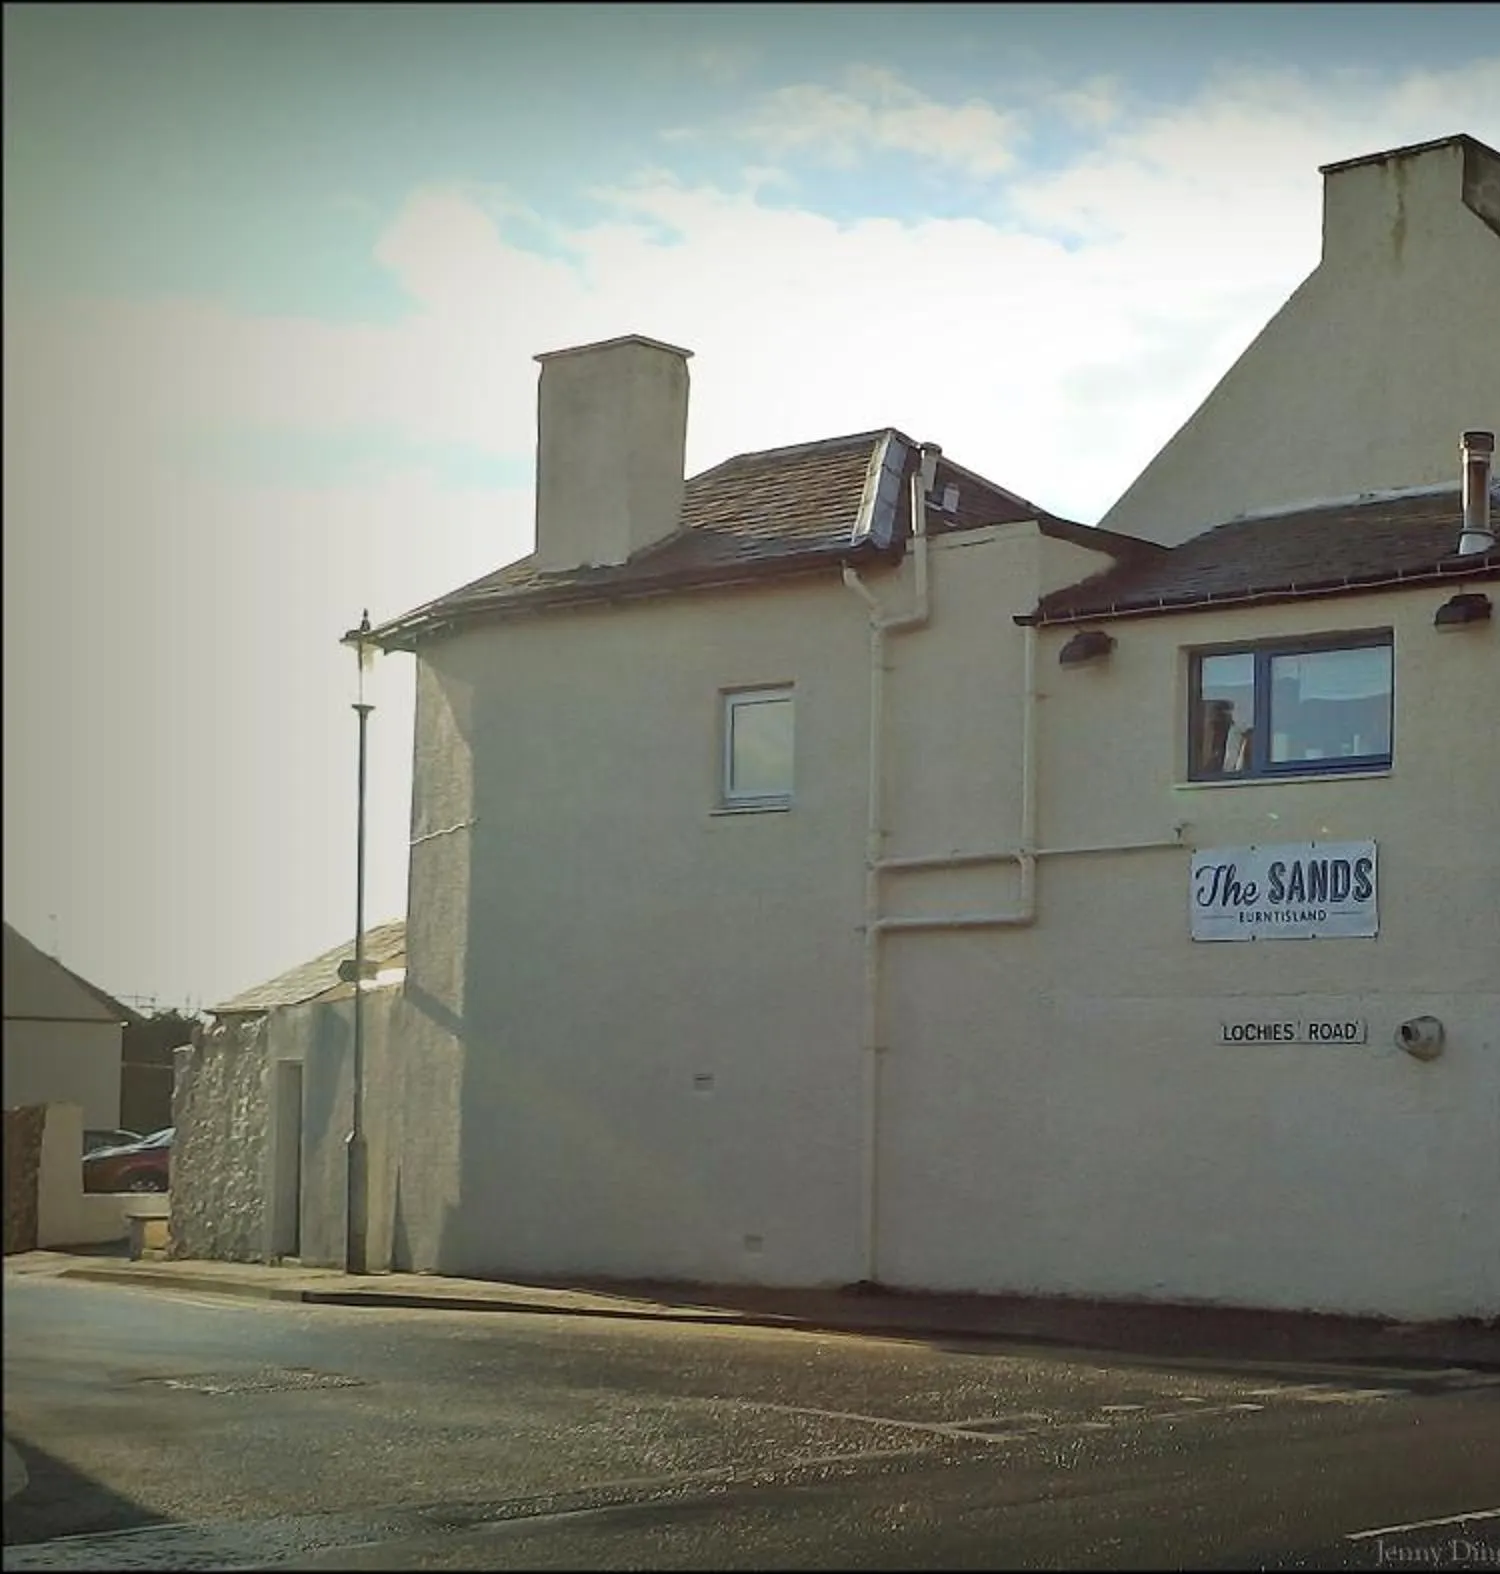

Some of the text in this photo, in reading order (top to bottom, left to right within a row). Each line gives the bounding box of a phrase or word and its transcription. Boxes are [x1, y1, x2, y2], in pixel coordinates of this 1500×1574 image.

[1195, 857, 1373, 907] The SANDS
[1239, 909, 1327, 923] BURNTISLAND
[1223, 1022, 1357, 1042] LOCHIES ROAD
